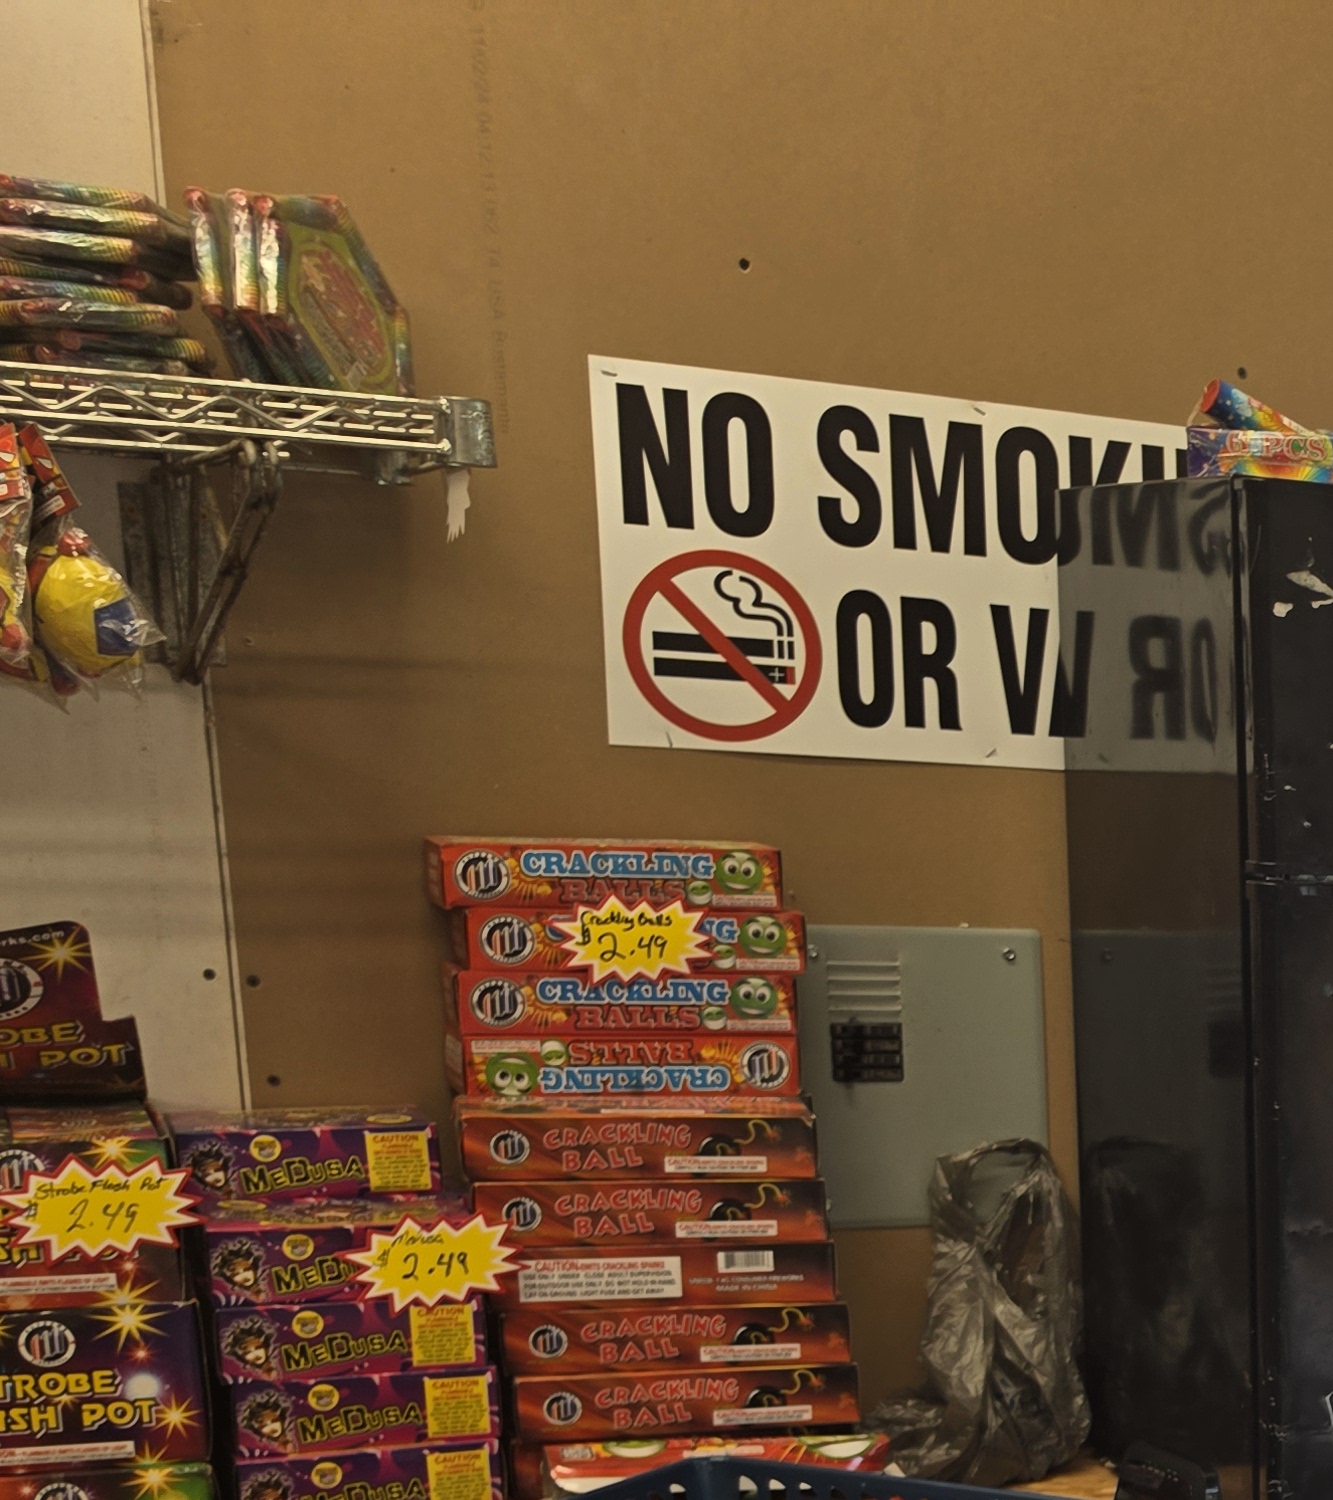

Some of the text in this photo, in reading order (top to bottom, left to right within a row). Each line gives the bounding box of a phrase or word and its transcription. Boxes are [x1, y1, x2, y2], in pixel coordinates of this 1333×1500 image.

[615, 382, 775, 538] NO
[817, 405, 1187, 566] SMO
[836, 589, 1062, 737] OR V
[520, 850, 714, 878] CRACKLING
[560, 878, 687, 902] BALLS
[537, 976, 730, 1004] CRACKLING
[575, 1005, 701, 1031] BALLS
[39, 1043, 128, 1067] POT
[568, 1039, 695, 1066] BALLS
[539, 1065, 732, 1094] CRACKLING
[372, 1134, 419, 1144] CAUTION
[543, 1121, 692, 1150] CRACKLING
[562, 1146, 644, 1172] BALL
[554, 1188, 703, 1216] CRACKLING
[573, 1211, 655, 1239] BALL
[401, 1251, 470, 1281] 2.49
[580, 1313, 727, 1343] CRACKLING
[600, 1337, 681, 1364] BALL
[594, 1377, 740, 1410] CRACKLING
[81, 1399, 158, 1428] POT
[613, 1401, 693, 1430] BALL
